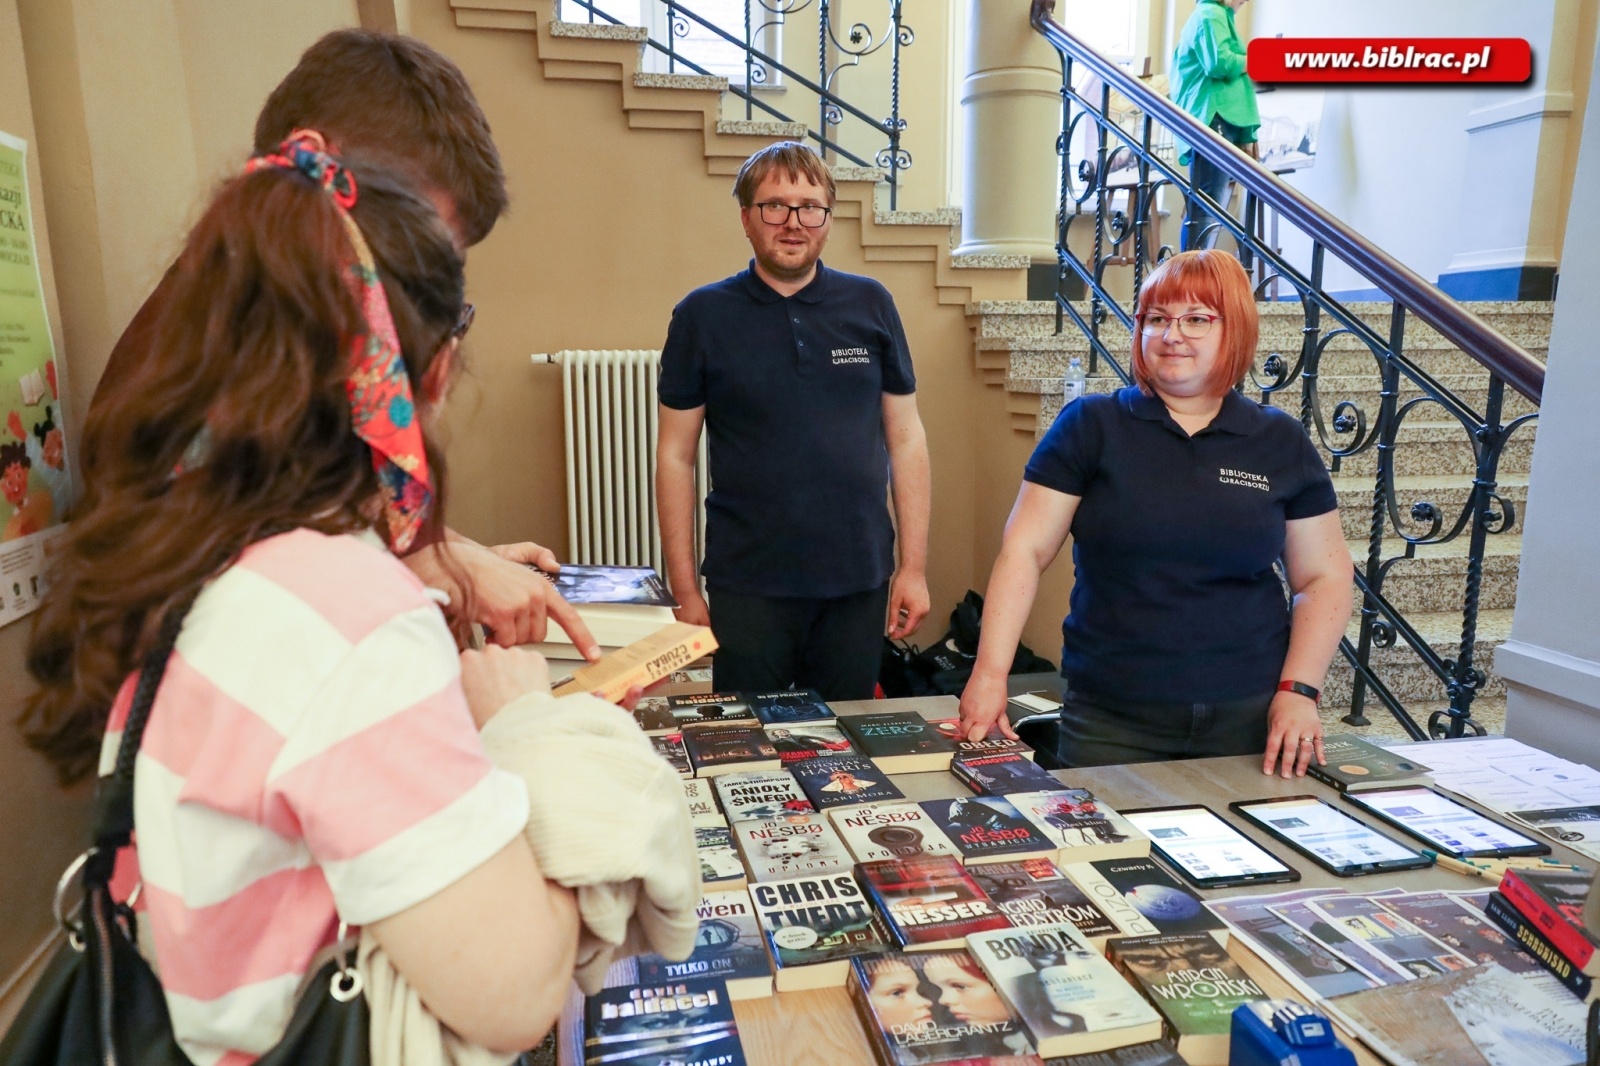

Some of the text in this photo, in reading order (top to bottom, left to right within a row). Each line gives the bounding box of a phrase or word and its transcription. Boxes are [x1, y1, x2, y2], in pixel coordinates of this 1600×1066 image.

[831, 347, 869, 357] BIBLIOTEKA
[1219, 467, 1270, 484] BIBLIOTEKA
[645, 643, 688, 672] CZUBAJ
[860, 724, 926, 736] ZERO
[802, 760, 860, 770] THOMAS
[963, 755, 1022, 768] DOMOFON
[800, 763, 872, 777] HARRIS
[722, 776, 790, 788] JAMES THOMPSON
[730, 783, 791, 797] ANIOŁY
[732, 792, 798, 807] ŚNIEGU
[821, 790, 893, 804] CARI MORA
[844, 811, 922, 828] NESBØ
[855, 809, 873, 817] JO
[761, 821, 778, 829] JO
[969, 825, 984, 834] JO
[1083, 819, 1108, 827] klucz
[749, 823, 824, 840] NESBØ
[960, 827, 1031, 844] NESBØ
[867, 842, 947, 859] POLICJA
[1110, 864, 1145, 873] Czwarty
[755, 876, 859, 907] CHRIS
[890, 900, 994, 927] NESSER
[1094, 883, 1155, 934] PUZO
[1490, 902, 1518, 930] SAM LLOYD
[984, 930, 1088, 962] BONDA
[1516, 924, 1571, 978] SCHRONISKO
[665, 960, 709, 977] TYLKO
[712, 957, 733, 970] ON
[1166, 967, 1229, 984] MARCIN
[629, 984, 688, 1000] david
[601, 989, 719, 1020] baldacci
[890, 1020, 938, 1036] DAVID
[893, 1021, 1014, 1046] LAGERCRANTZ
